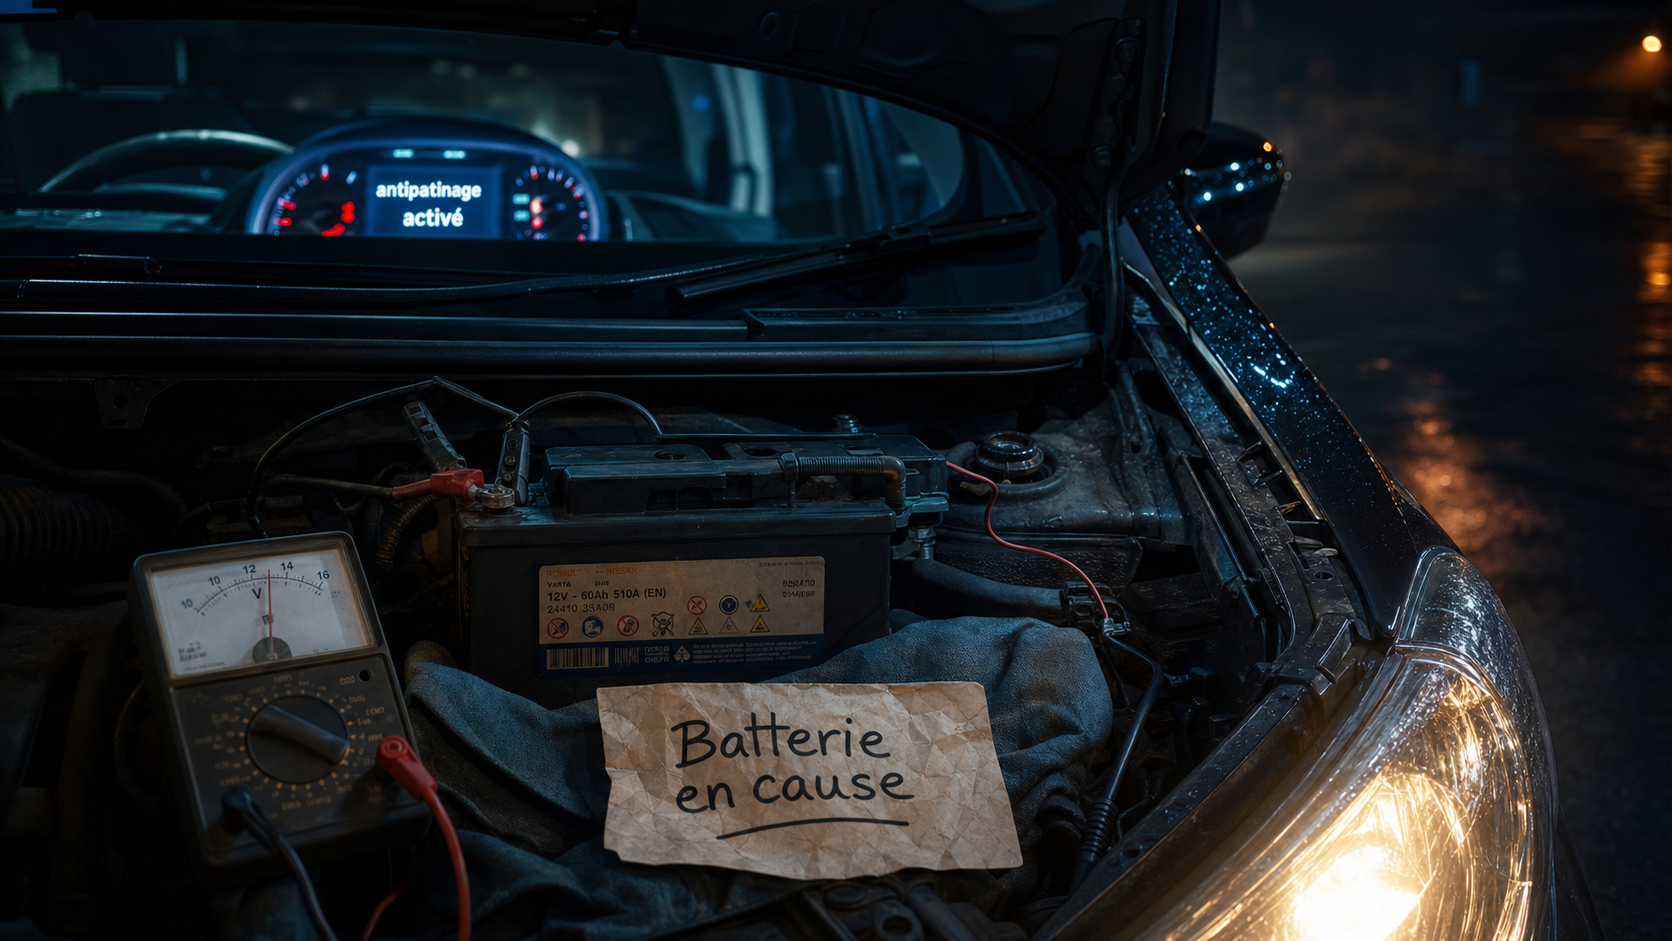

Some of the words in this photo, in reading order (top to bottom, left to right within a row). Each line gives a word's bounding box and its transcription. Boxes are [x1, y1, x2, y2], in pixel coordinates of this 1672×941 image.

[375, 180, 482, 202] antipatinage
[402, 207, 464, 228] activé
[180, 598, 194, 610] 10
[208, 575, 221, 586] 10
[242, 564, 257, 575] 12
[280, 561, 294, 571] 14
[316, 570, 330, 580] 16
[252, 587, 262, 600] V
[547, 592, 569, 602] 12V
[581, 590, 609, 601] 60Ah
[613, 589, 640, 599] 510A
[644, 587, 667, 600] (EN)
[547, 604, 578, 614] 24410
[671, 712, 892, 769] Batterie
[675, 782, 735, 814] en
[752, 771, 915, 804] cause
